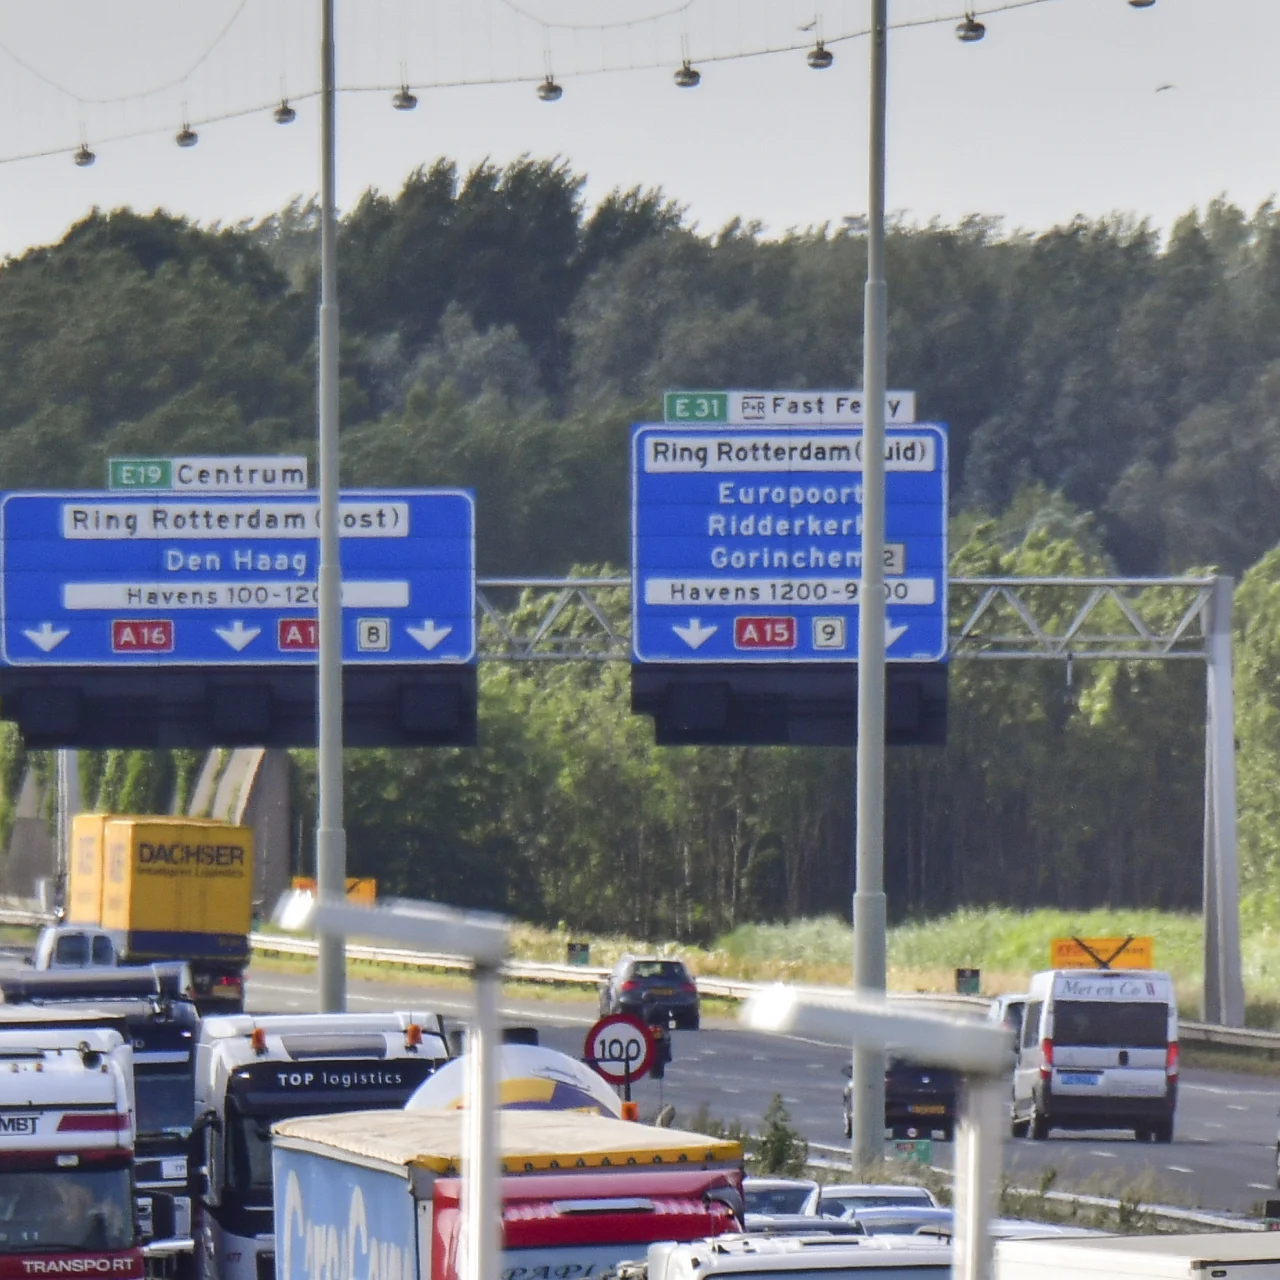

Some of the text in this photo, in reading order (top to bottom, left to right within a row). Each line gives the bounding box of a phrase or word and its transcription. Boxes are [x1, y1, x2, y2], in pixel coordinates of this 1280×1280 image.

[772, 397, 825, 415] Fast
[835, 396, 901, 418] Fey
[652, 440, 928, 468] Ring Rotterdam (uid)
[121, 463, 305, 485] E19 Centrum
[719, 481, 863, 508] Europoort
[72, 508, 400, 536] Ring Rotterdam (ost)
[707, 514, 864, 537] Ridderker
[166, 548, 307, 576] Den Haag
[711, 546, 863, 569] Gorinchem
[126, 585, 342, 605] Havens 100-12
[670, 582, 909, 600] Havens 1200-900
[119, 627, 167, 646] A16
[286, 625, 320, 644] A1
[821, 623, 836, 641] 9
[138, 843, 245, 866] DACHSER
[599, 1038, 641, 1061] 100
[276, 1071, 403, 1088] TOP logistics
[22, 1257, 134, 1273] TRANSPORT
